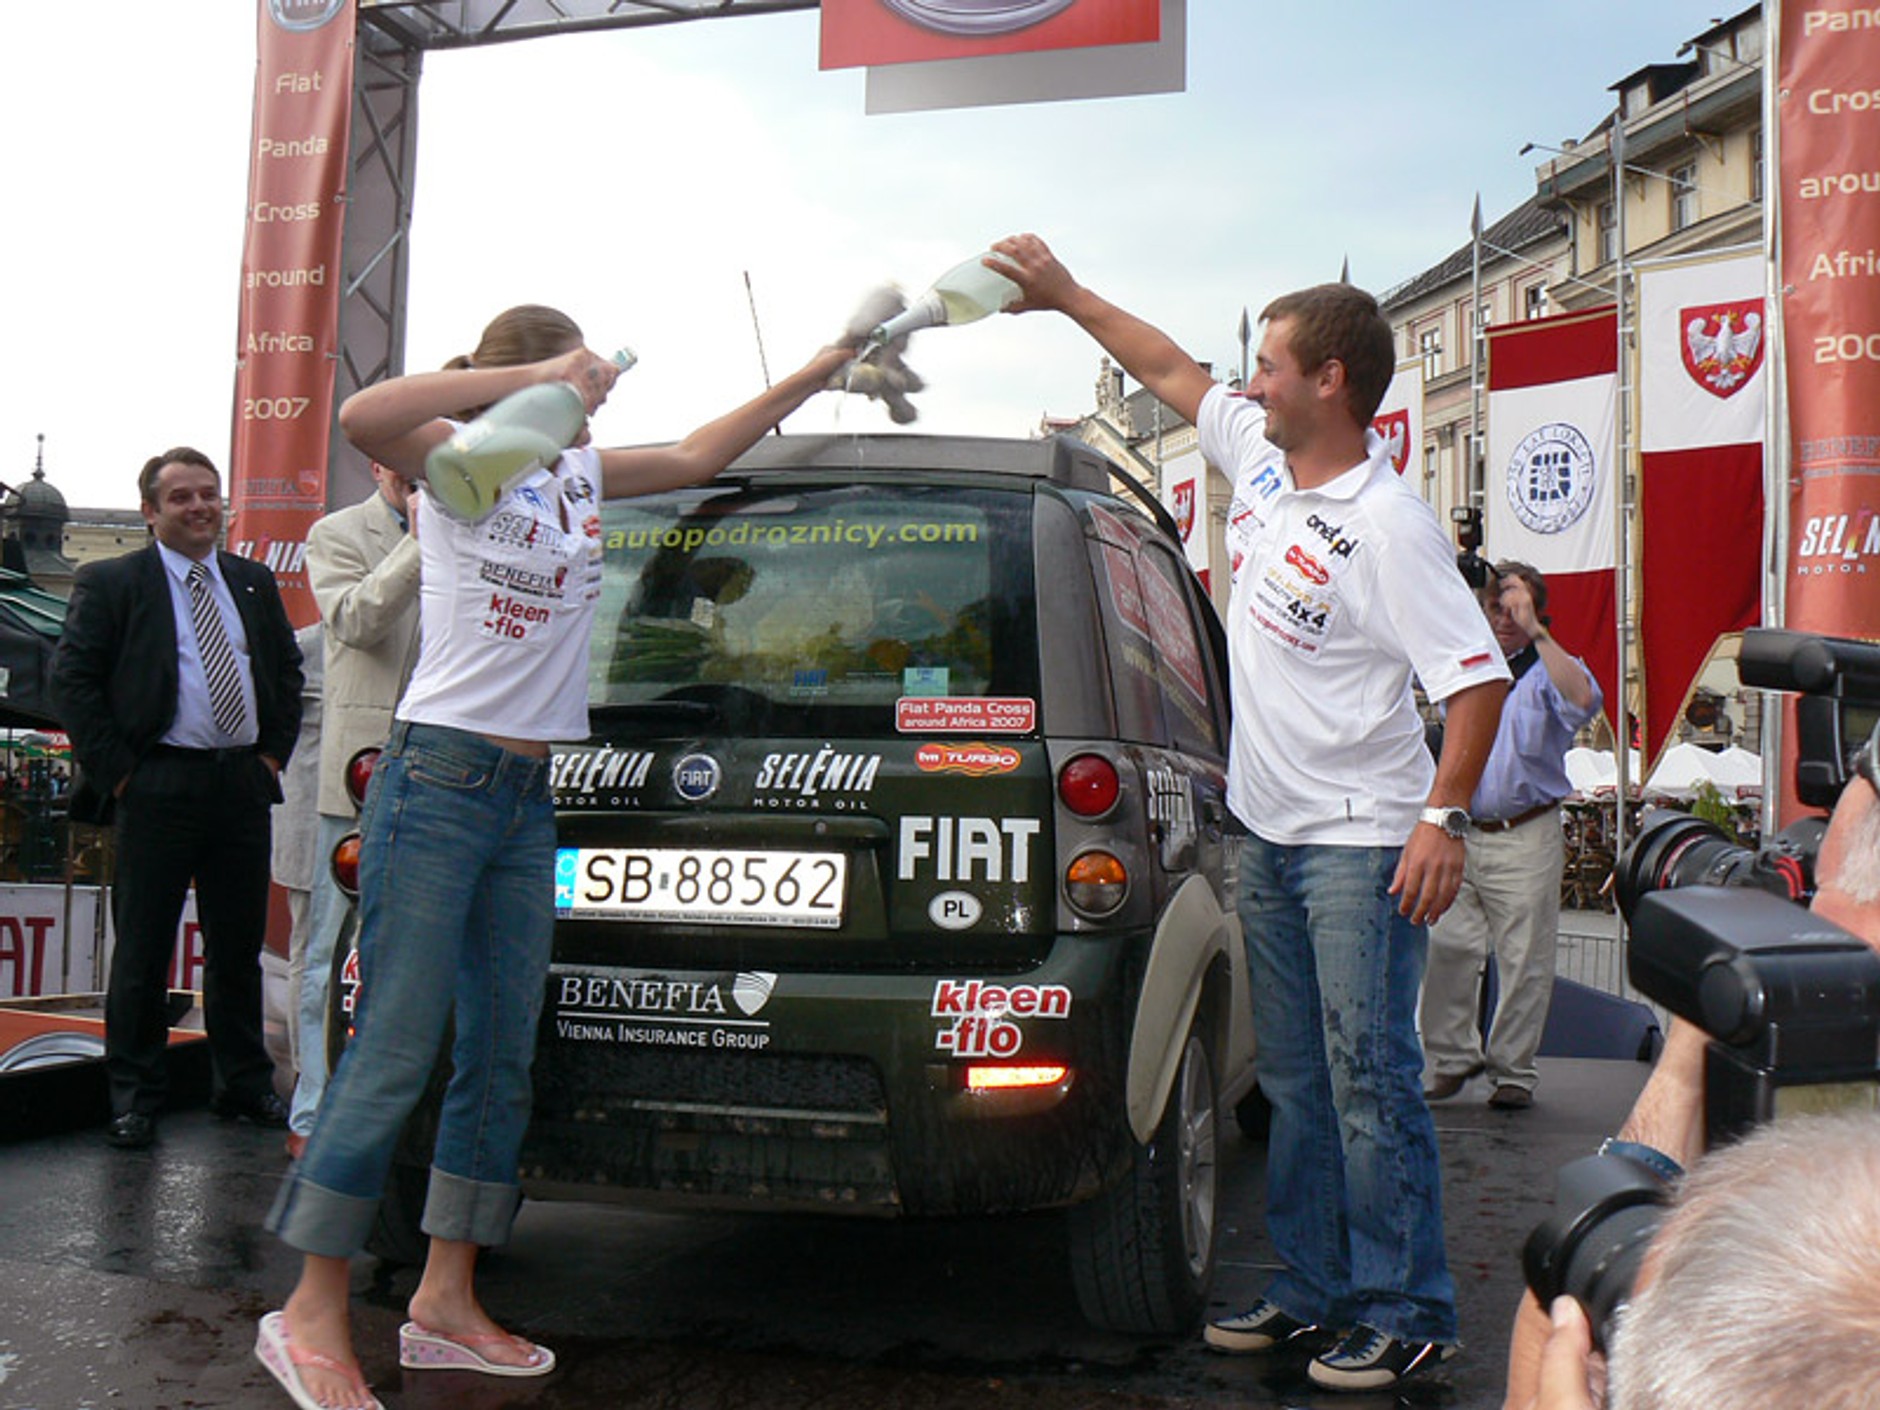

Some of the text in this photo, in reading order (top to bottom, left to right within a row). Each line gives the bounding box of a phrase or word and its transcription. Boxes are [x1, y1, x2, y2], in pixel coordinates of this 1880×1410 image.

[275, 71, 322, 94] Fiat
[258, 137, 328, 158] Panda
[254, 201, 320, 222] Cross
[1808, 249, 1880, 281] Afri
[247, 331, 314, 353] Africa
[244, 398, 310, 420] 2007
[606, 519, 978, 551] autopodroznicy.com
[489, 593, 550, 624] kleen
[1287, 599, 1328, 629] 4x4
[484, 615, 526, 639] -flo
[900, 702, 1030, 714] Fiat Panda Cross
[904, 716, 1026, 728] around Africa 2007
[946, 751, 1017, 766] TURBO
[680, 769, 713, 788] FIAT
[552, 796, 641, 805] OTOR OIL
[754, 798, 869, 810] MOTOR OIL
[897, 816, 1040, 882] FIAT
[585, 855, 838, 909] SB 88562
[943, 900, 970, 918] PL
[557, 977, 727, 1014] BENEFIA
[932, 980, 1071, 1017] kleen
[936, 1016, 1021, 1056] -flo
